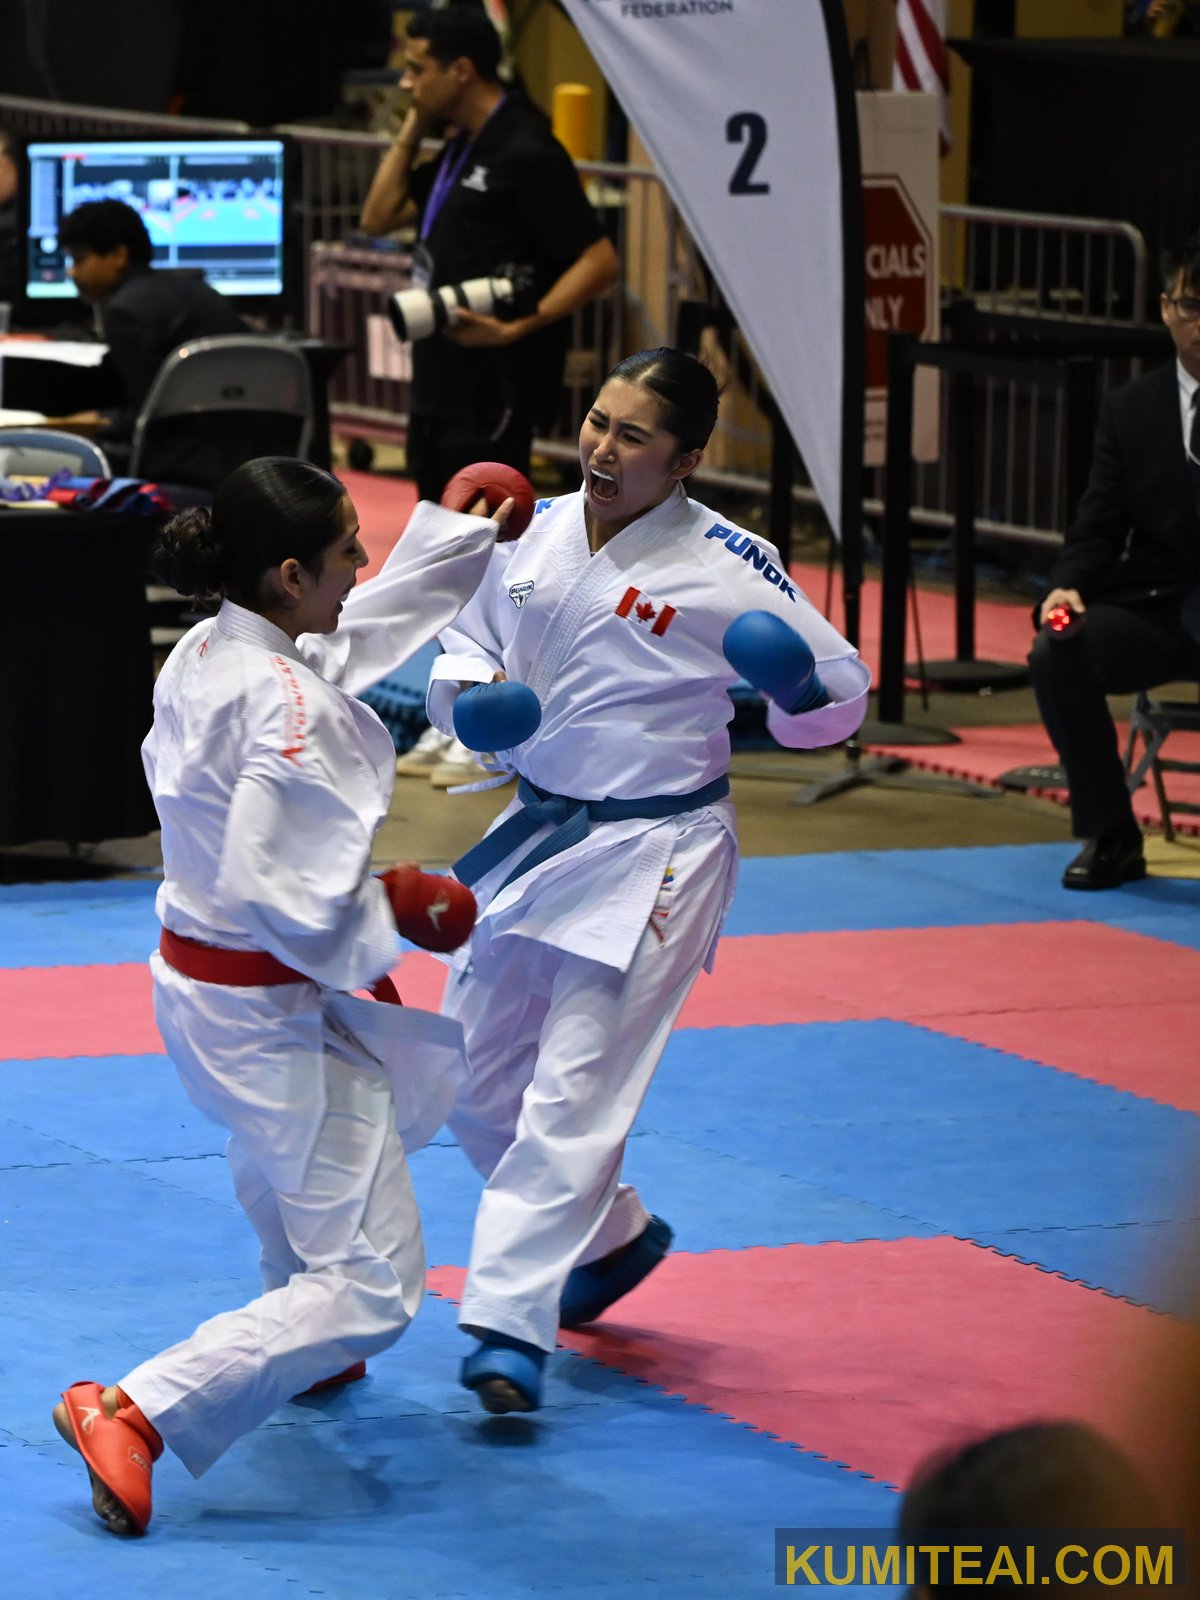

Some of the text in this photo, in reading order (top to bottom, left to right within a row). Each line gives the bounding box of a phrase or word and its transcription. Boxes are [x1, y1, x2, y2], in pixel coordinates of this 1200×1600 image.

[621, 0, 734, 18] FEDERATION
[726, 112, 770, 195] 2
[865, 244, 925, 279] CIALS
[864, 295, 904, 330] NLY
[704, 523, 797, 604] PUNOK
